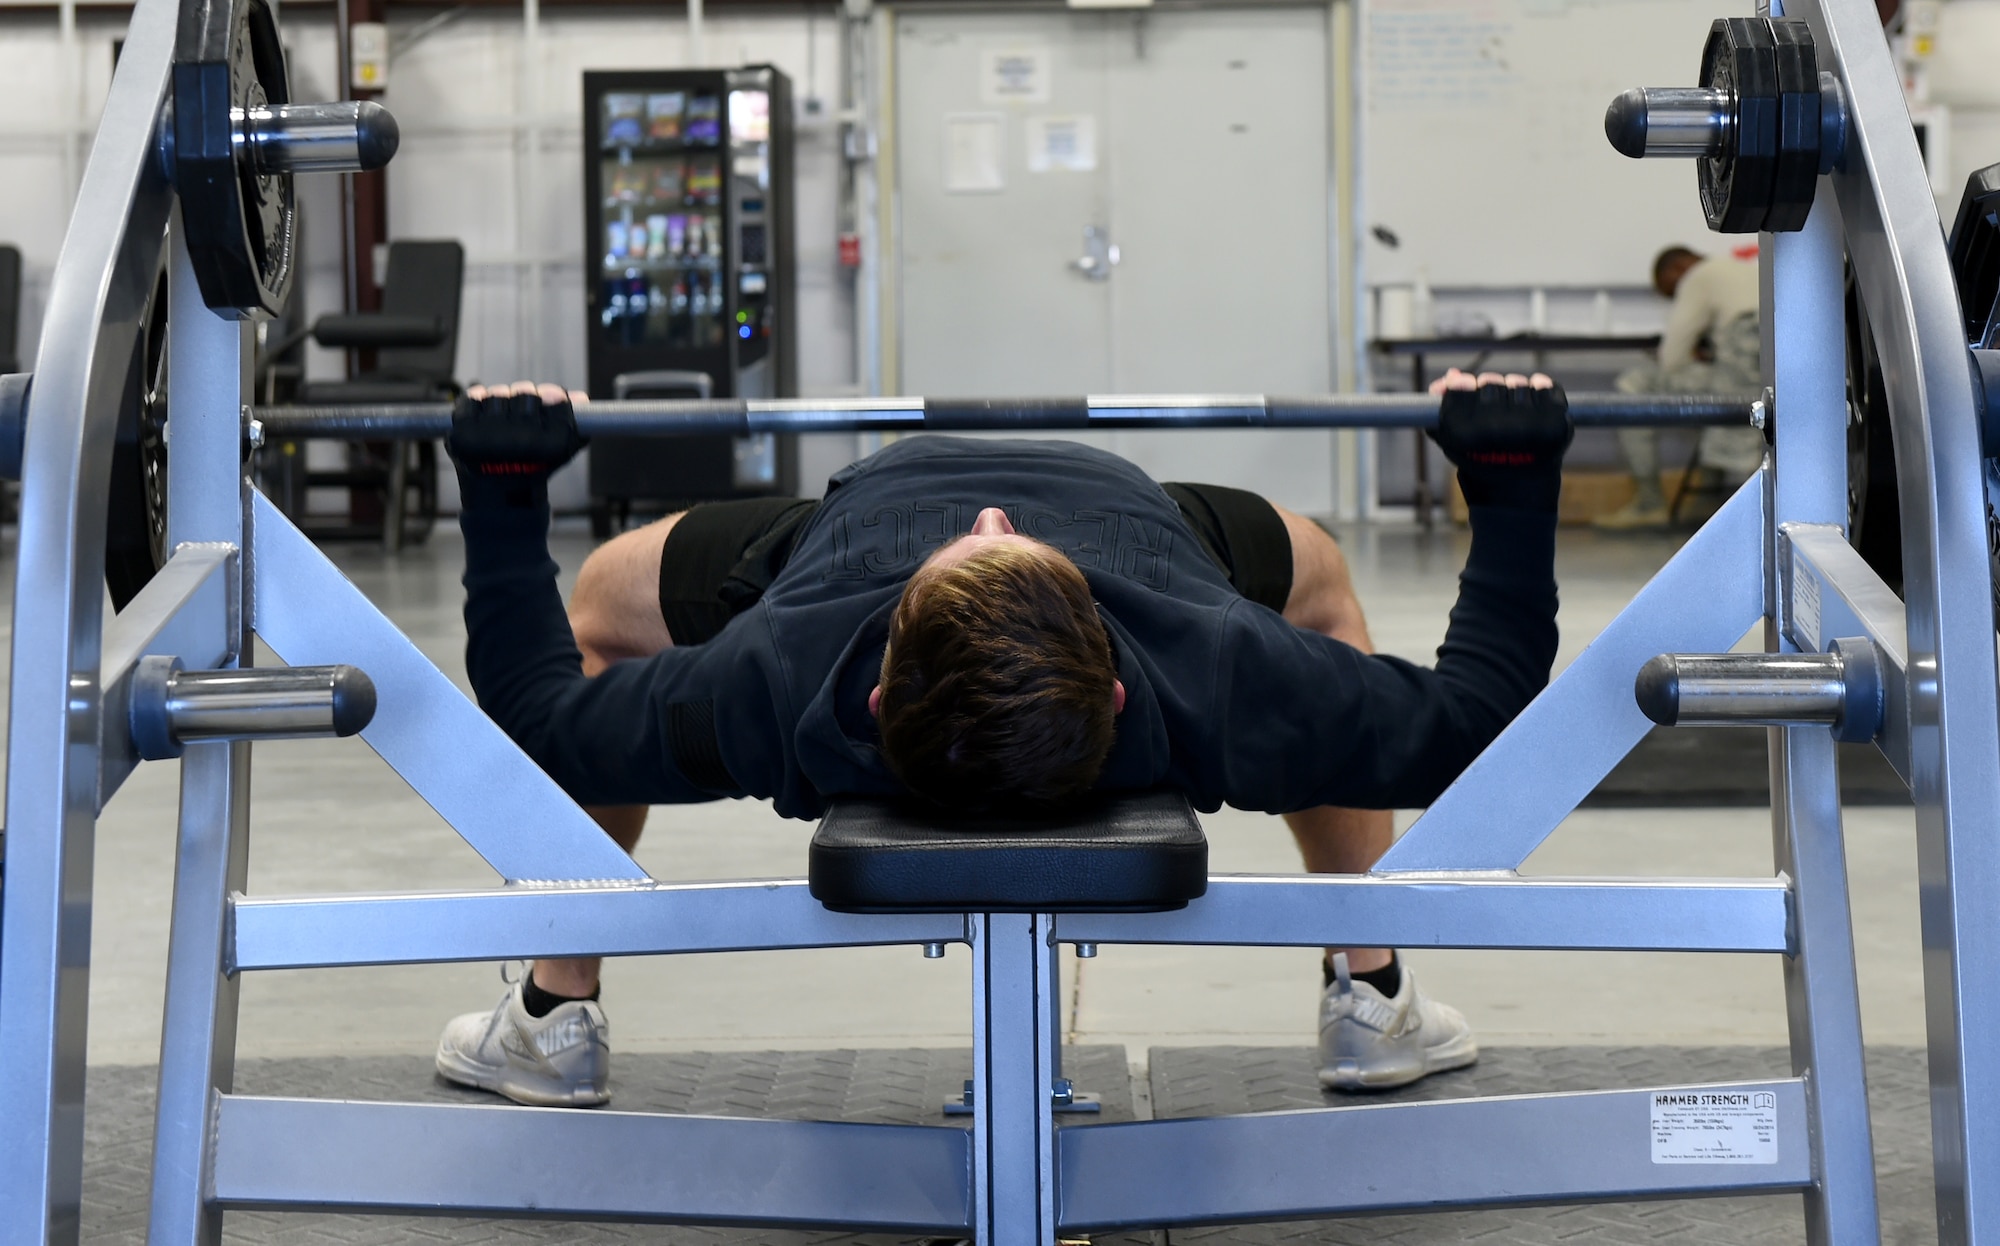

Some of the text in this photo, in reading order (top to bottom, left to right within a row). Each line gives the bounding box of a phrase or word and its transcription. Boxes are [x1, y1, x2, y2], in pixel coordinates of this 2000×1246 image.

[823, 501, 1174, 592] RESECT
[536, 1019, 581, 1056] NIKE
[1656, 1095, 1749, 1107] HAMMER STRENGTH
